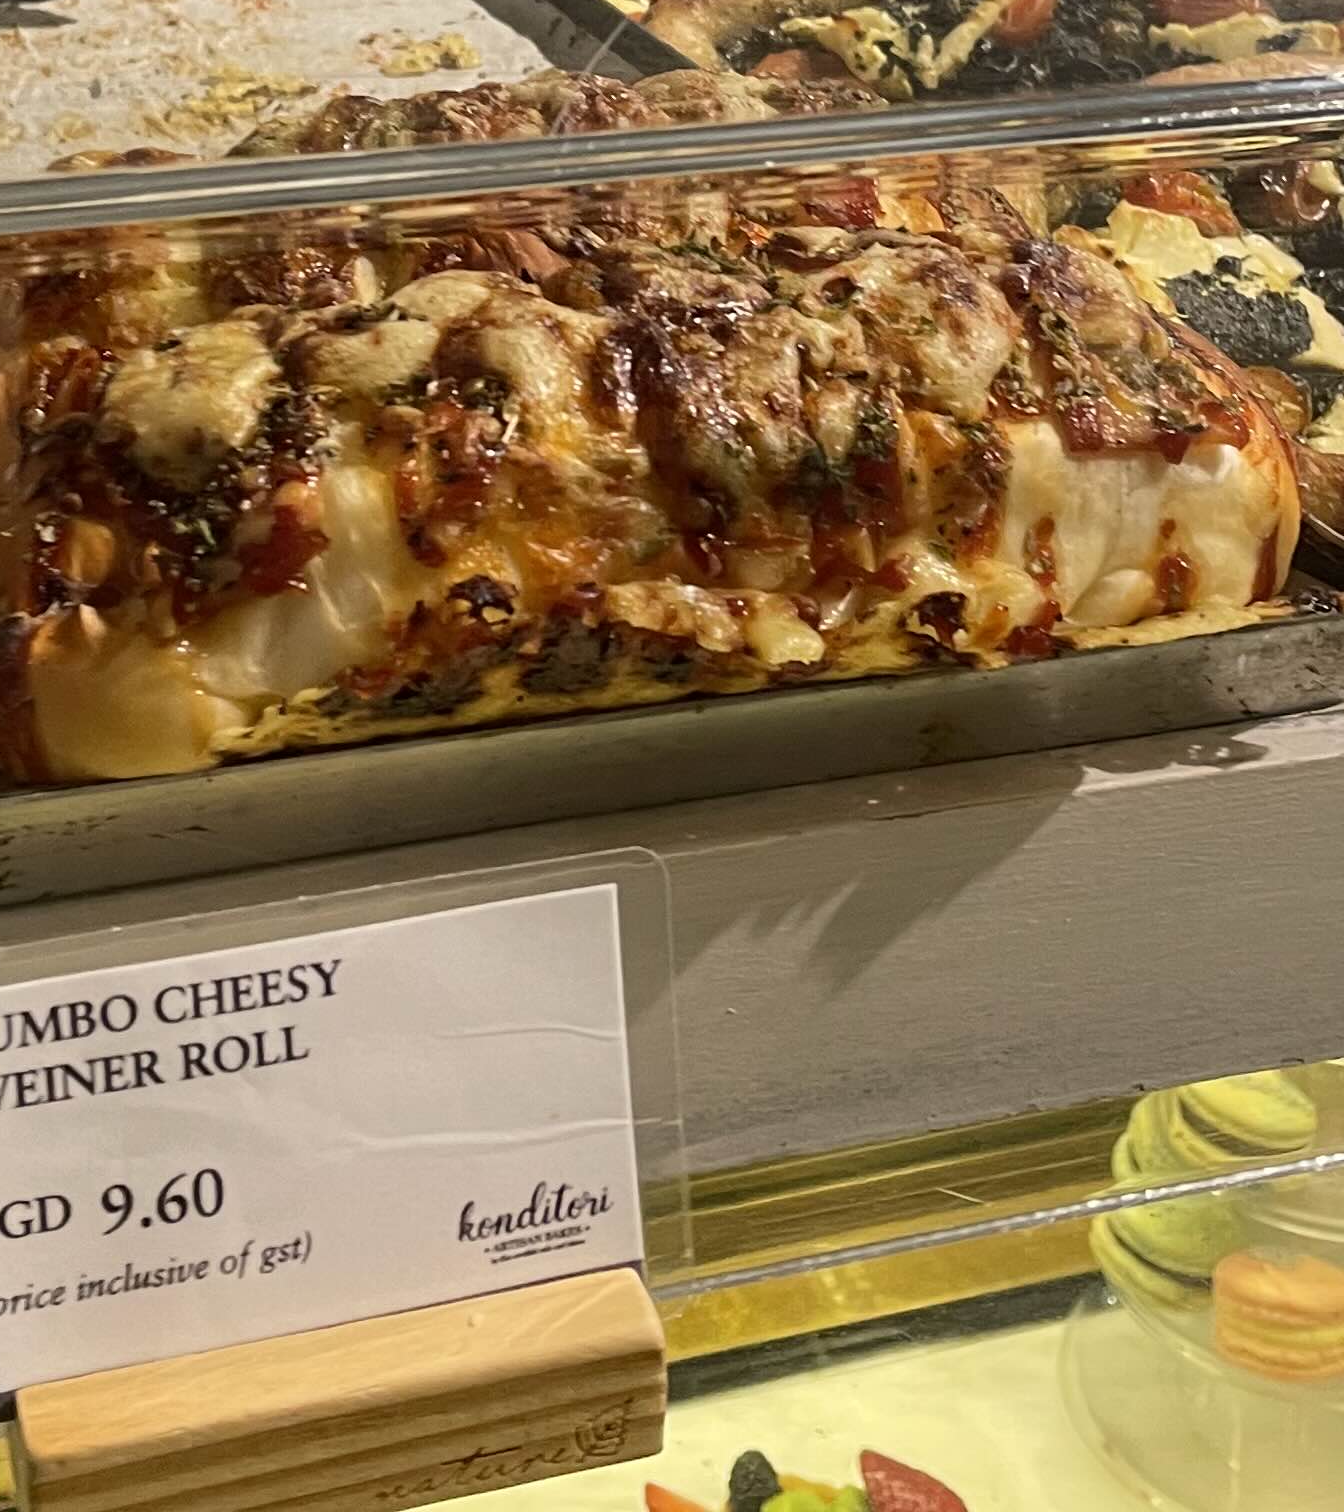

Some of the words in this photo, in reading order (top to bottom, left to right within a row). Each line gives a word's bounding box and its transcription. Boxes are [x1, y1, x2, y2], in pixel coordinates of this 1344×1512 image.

[155, 959, 343, 1024] CHEESY
[179, 1025, 310, 1081] ROLL
[100, 1168, 225, 1237] 9.60
[458, 1180, 615, 1242] konditori
[76, 1256, 209, 1302] inclusive
[219, 1239, 256, 1279] of
[259, 1230, 313, 1274] gst)
